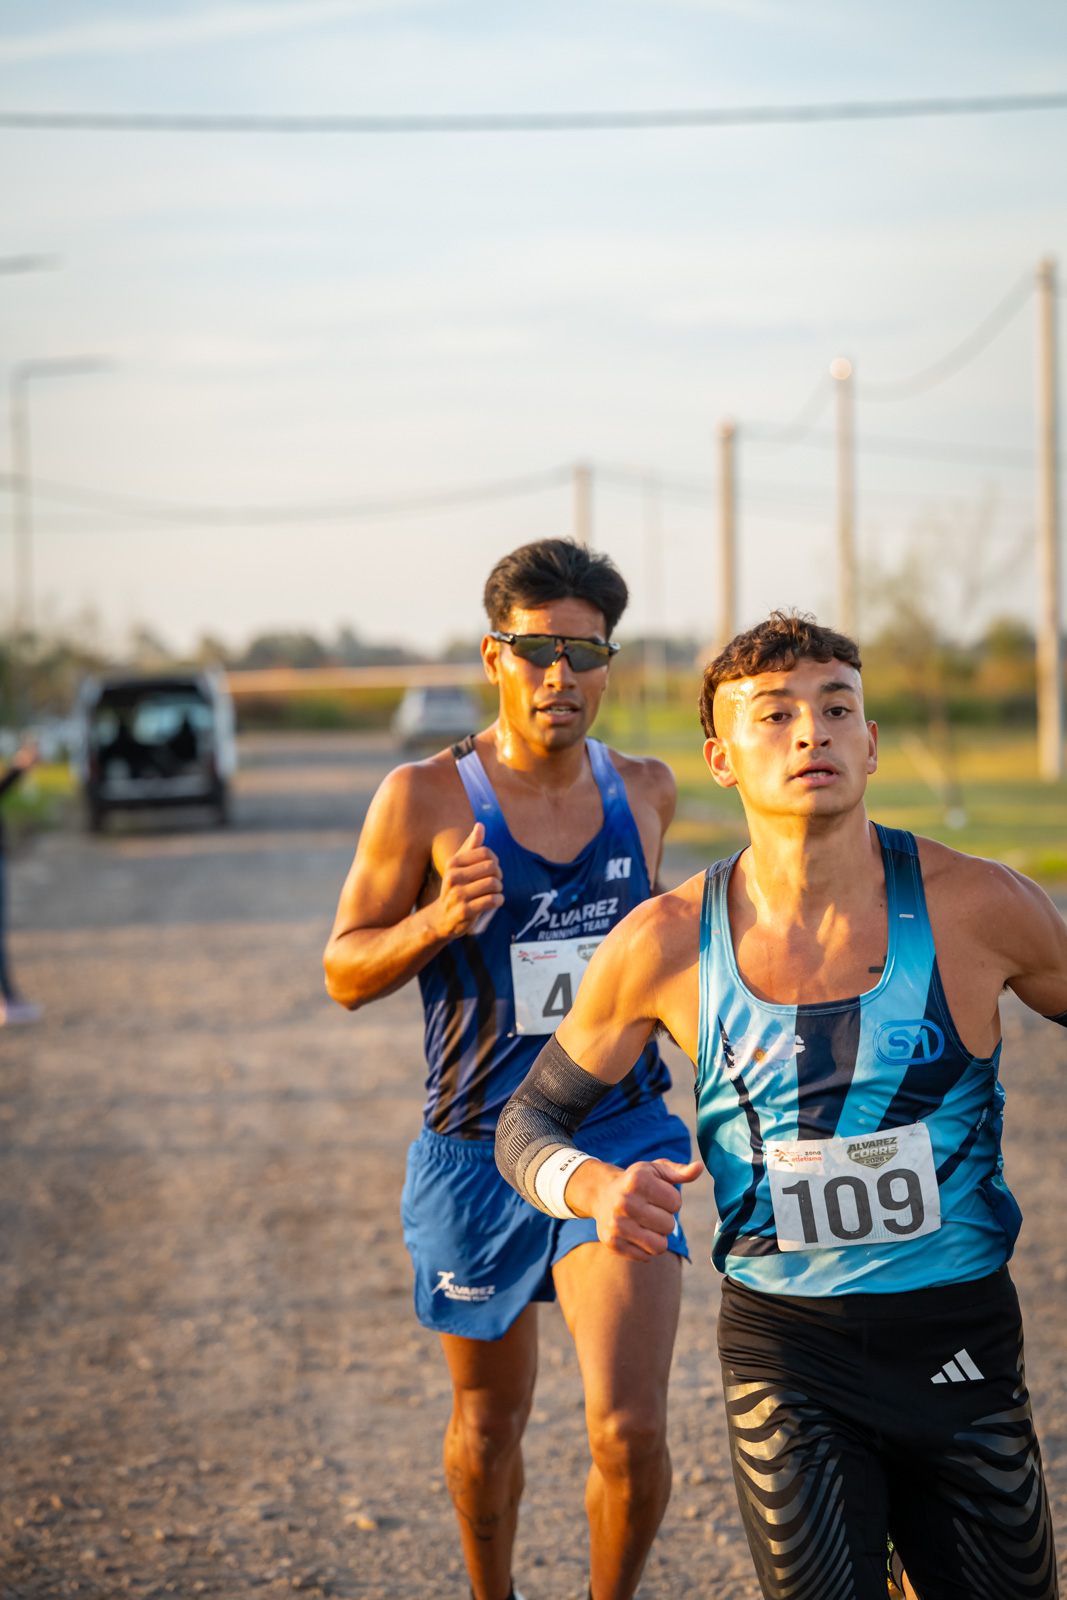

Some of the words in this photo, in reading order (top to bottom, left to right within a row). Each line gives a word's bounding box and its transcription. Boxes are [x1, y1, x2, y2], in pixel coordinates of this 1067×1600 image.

[537, 925, 580, 940] RUNNING
[583, 918, 610, 932] TEAM
[847, 1136, 898, 1153] ALVAREZ
[851, 1145, 897, 1160] CORRE
[865, 1156, 885, 1164] 2026
[782, 1168, 925, 1244] 109
